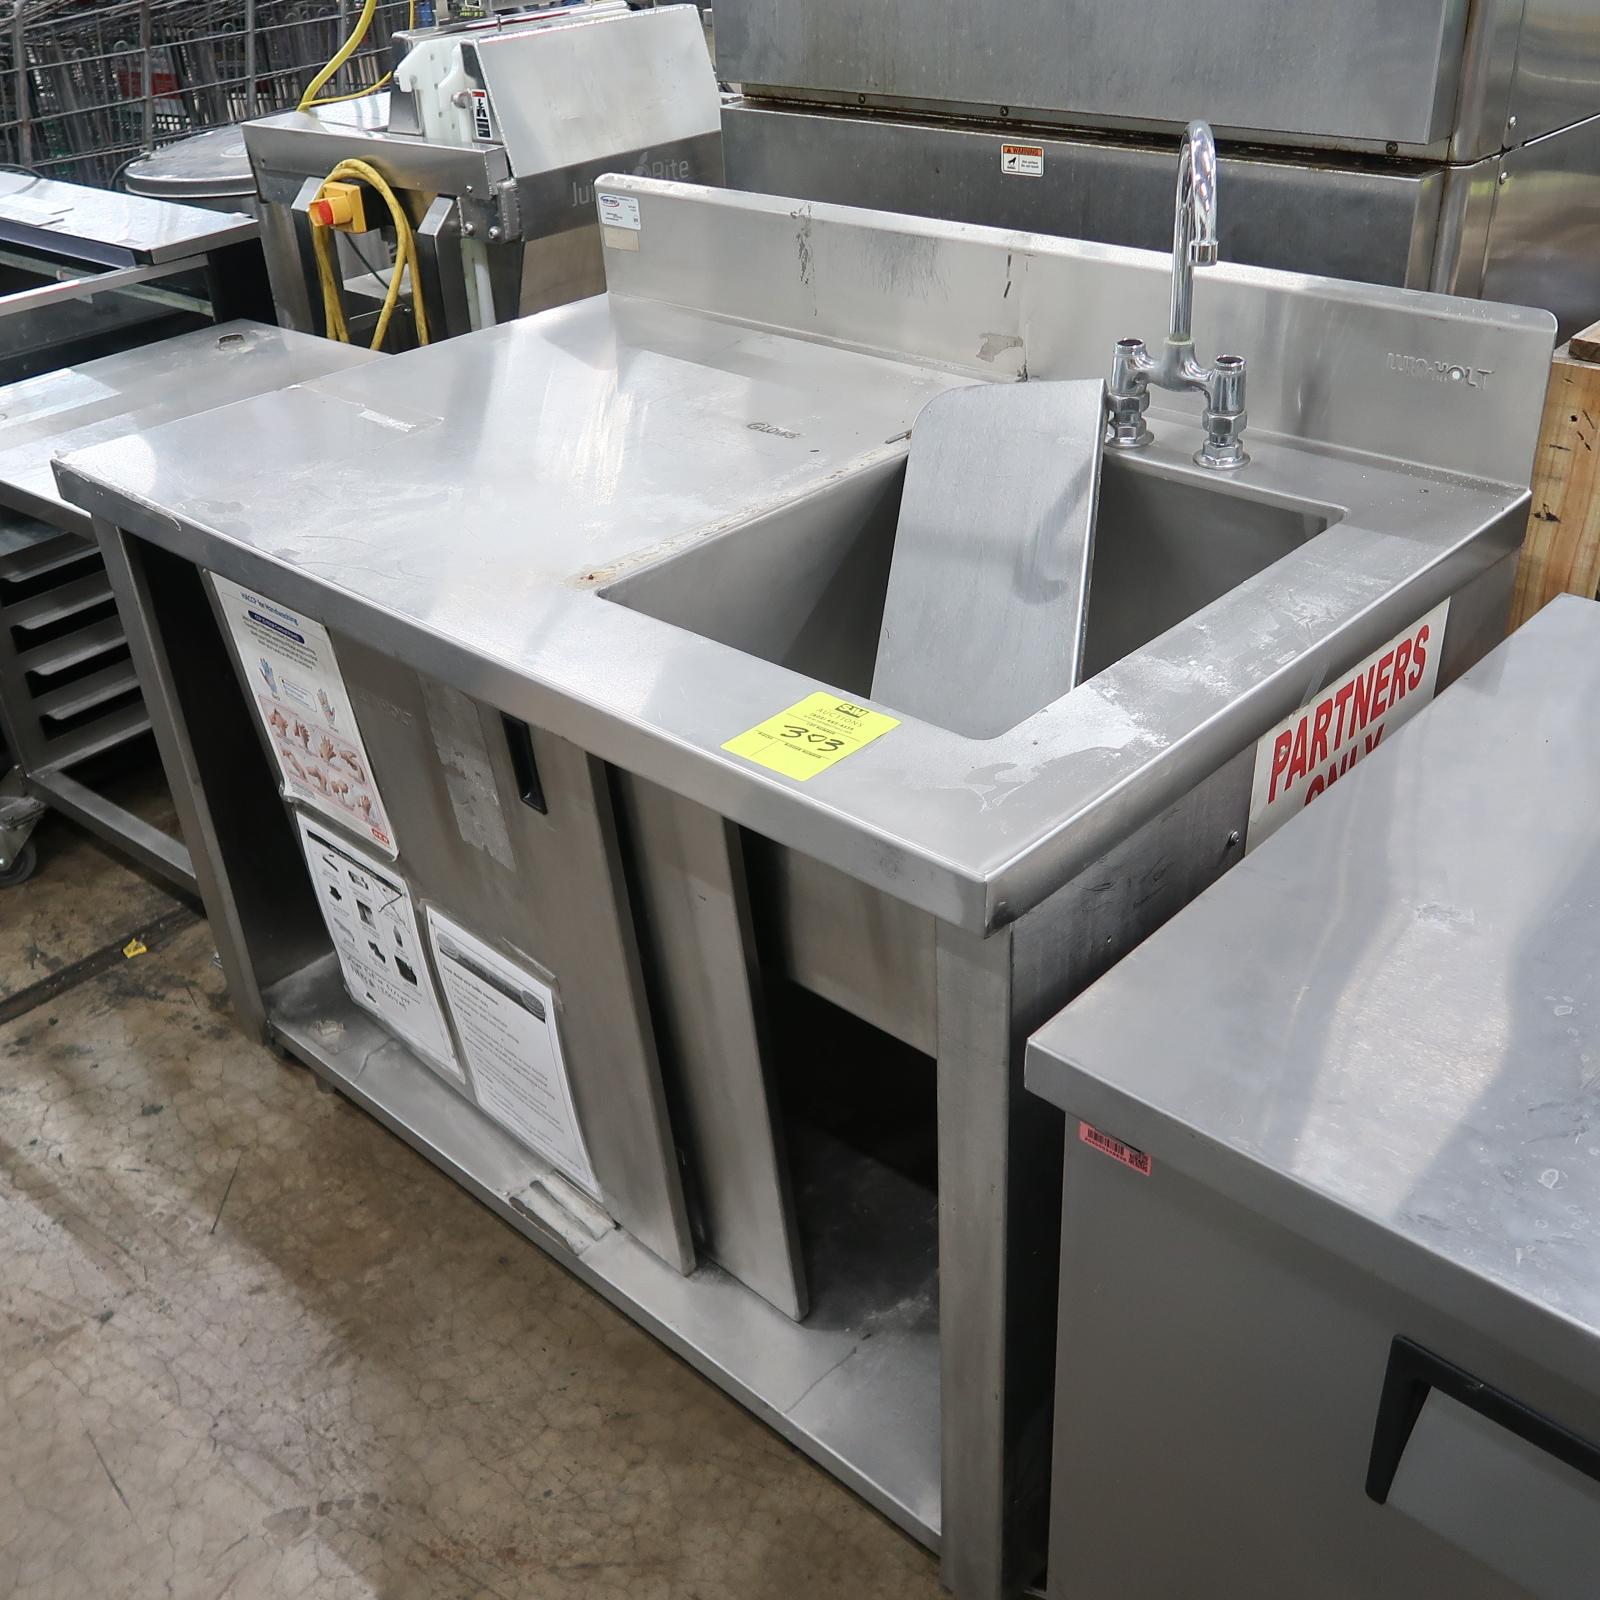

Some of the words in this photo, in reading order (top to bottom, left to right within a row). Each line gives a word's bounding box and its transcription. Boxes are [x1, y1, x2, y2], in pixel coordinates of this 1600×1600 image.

[815, 708, 865, 728] AUCTIONS
[1268, 625, 1430, 804] PARTNERS
[780, 724, 845, 752] 303
